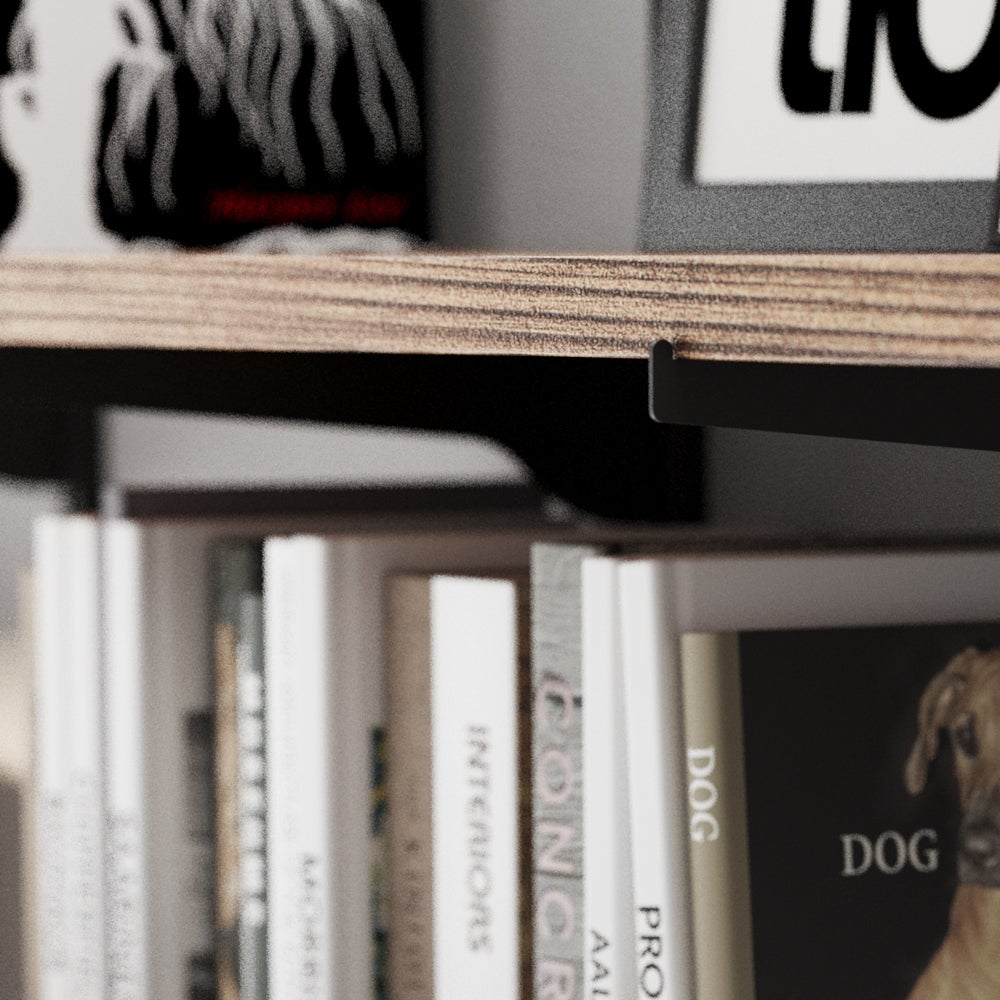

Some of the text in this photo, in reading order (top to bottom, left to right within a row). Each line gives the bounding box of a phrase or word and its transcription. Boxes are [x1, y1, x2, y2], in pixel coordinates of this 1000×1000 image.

[465, 724, 493, 952] INTERIORS
[687, 746, 719, 842] DOG
[840, 828, 939, 876] DOG
